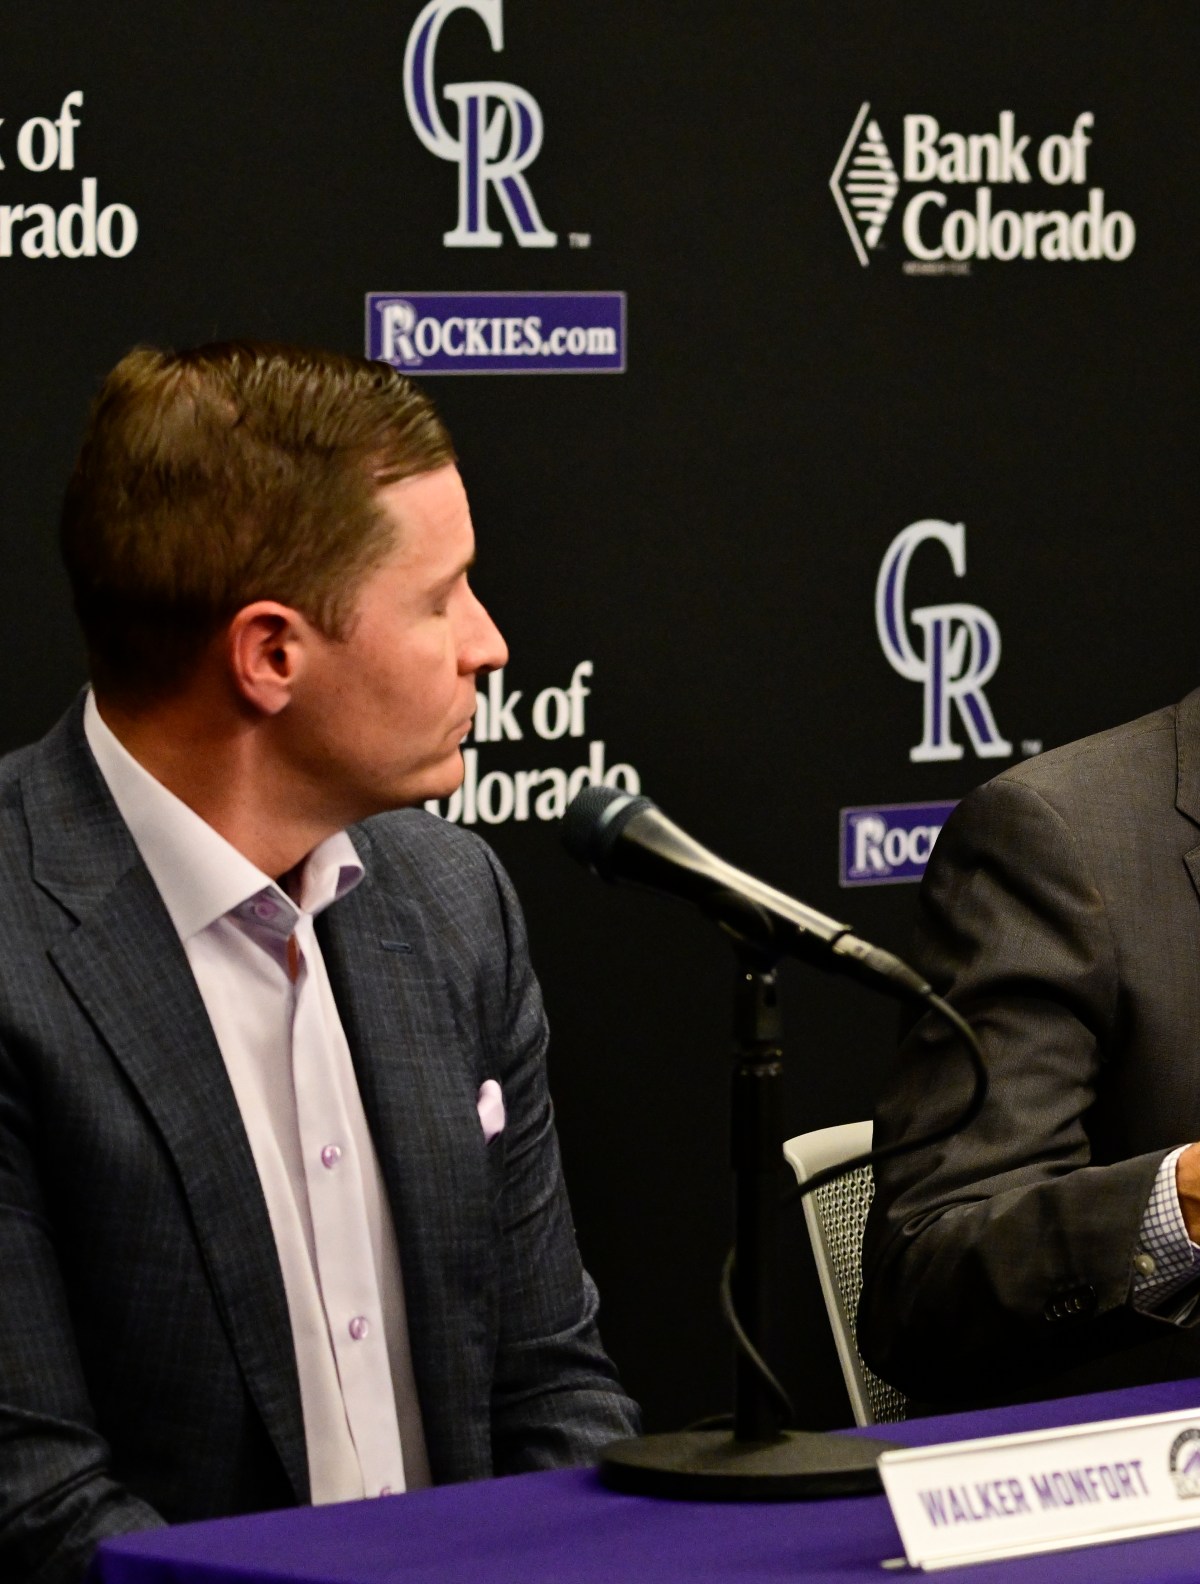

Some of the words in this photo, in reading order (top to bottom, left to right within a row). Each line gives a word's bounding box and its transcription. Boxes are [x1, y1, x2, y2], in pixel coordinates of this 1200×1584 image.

[17, 90, 84, 172] of
[903, 111, 1031, 184] Bank
[1038, 112, 1094, 184] of
[902, 187, 1136, 261] Colorado
[532, 660, 594, 740] of
[424, 740, 641, 825] olorado
[918, 1478, 1026, 1527] WALKER
[1030, 1459, 1151, 1510] MONFORT
